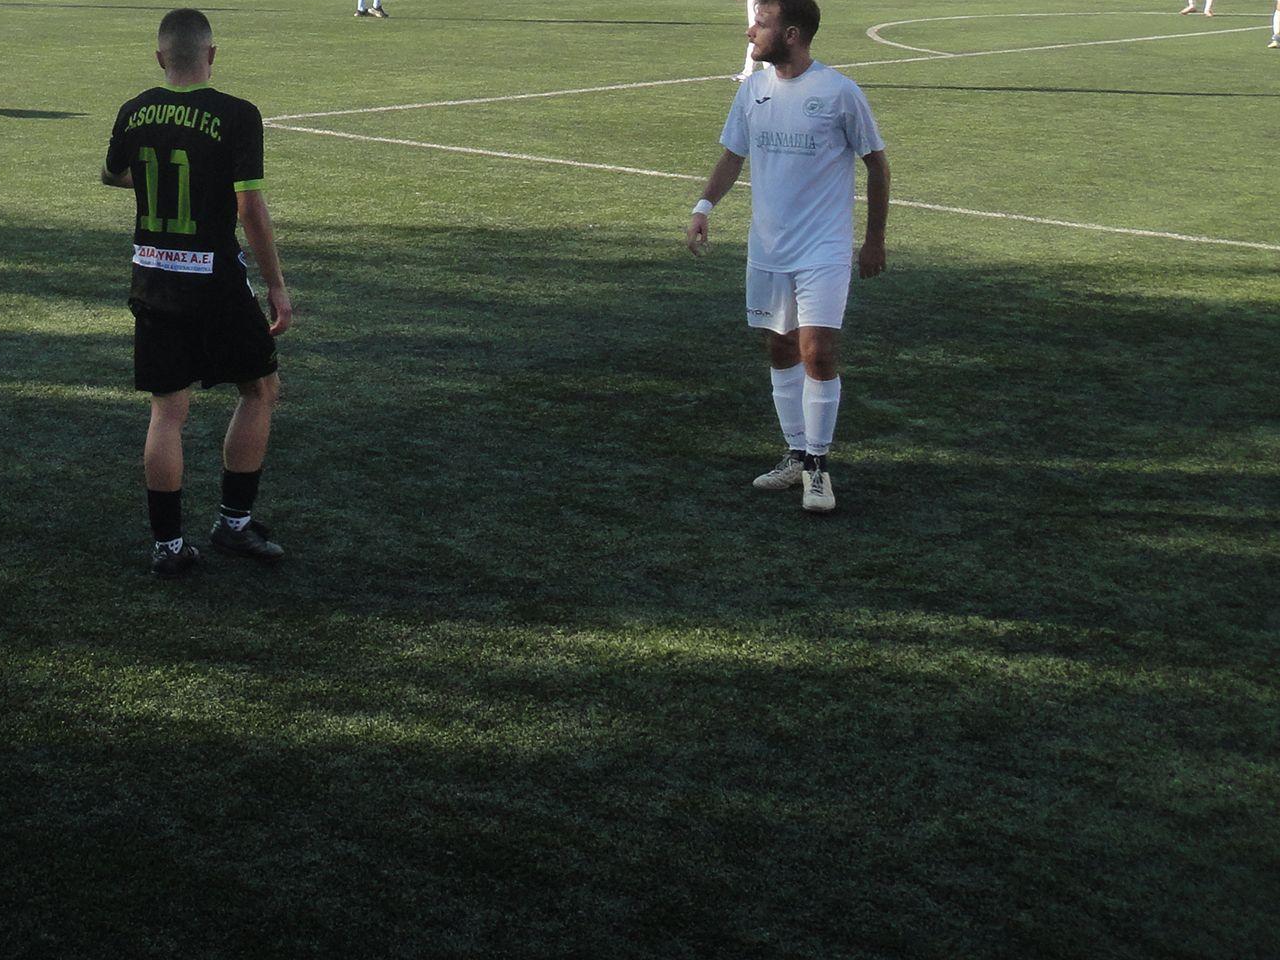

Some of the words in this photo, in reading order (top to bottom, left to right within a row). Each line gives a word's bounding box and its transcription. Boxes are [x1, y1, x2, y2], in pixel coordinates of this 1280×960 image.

[199, 111, 221, 141] F.C.
[137, 146, 197, 235] 11
[138, 245, 187, 263] ΔΙΑΥΝΑΣ
